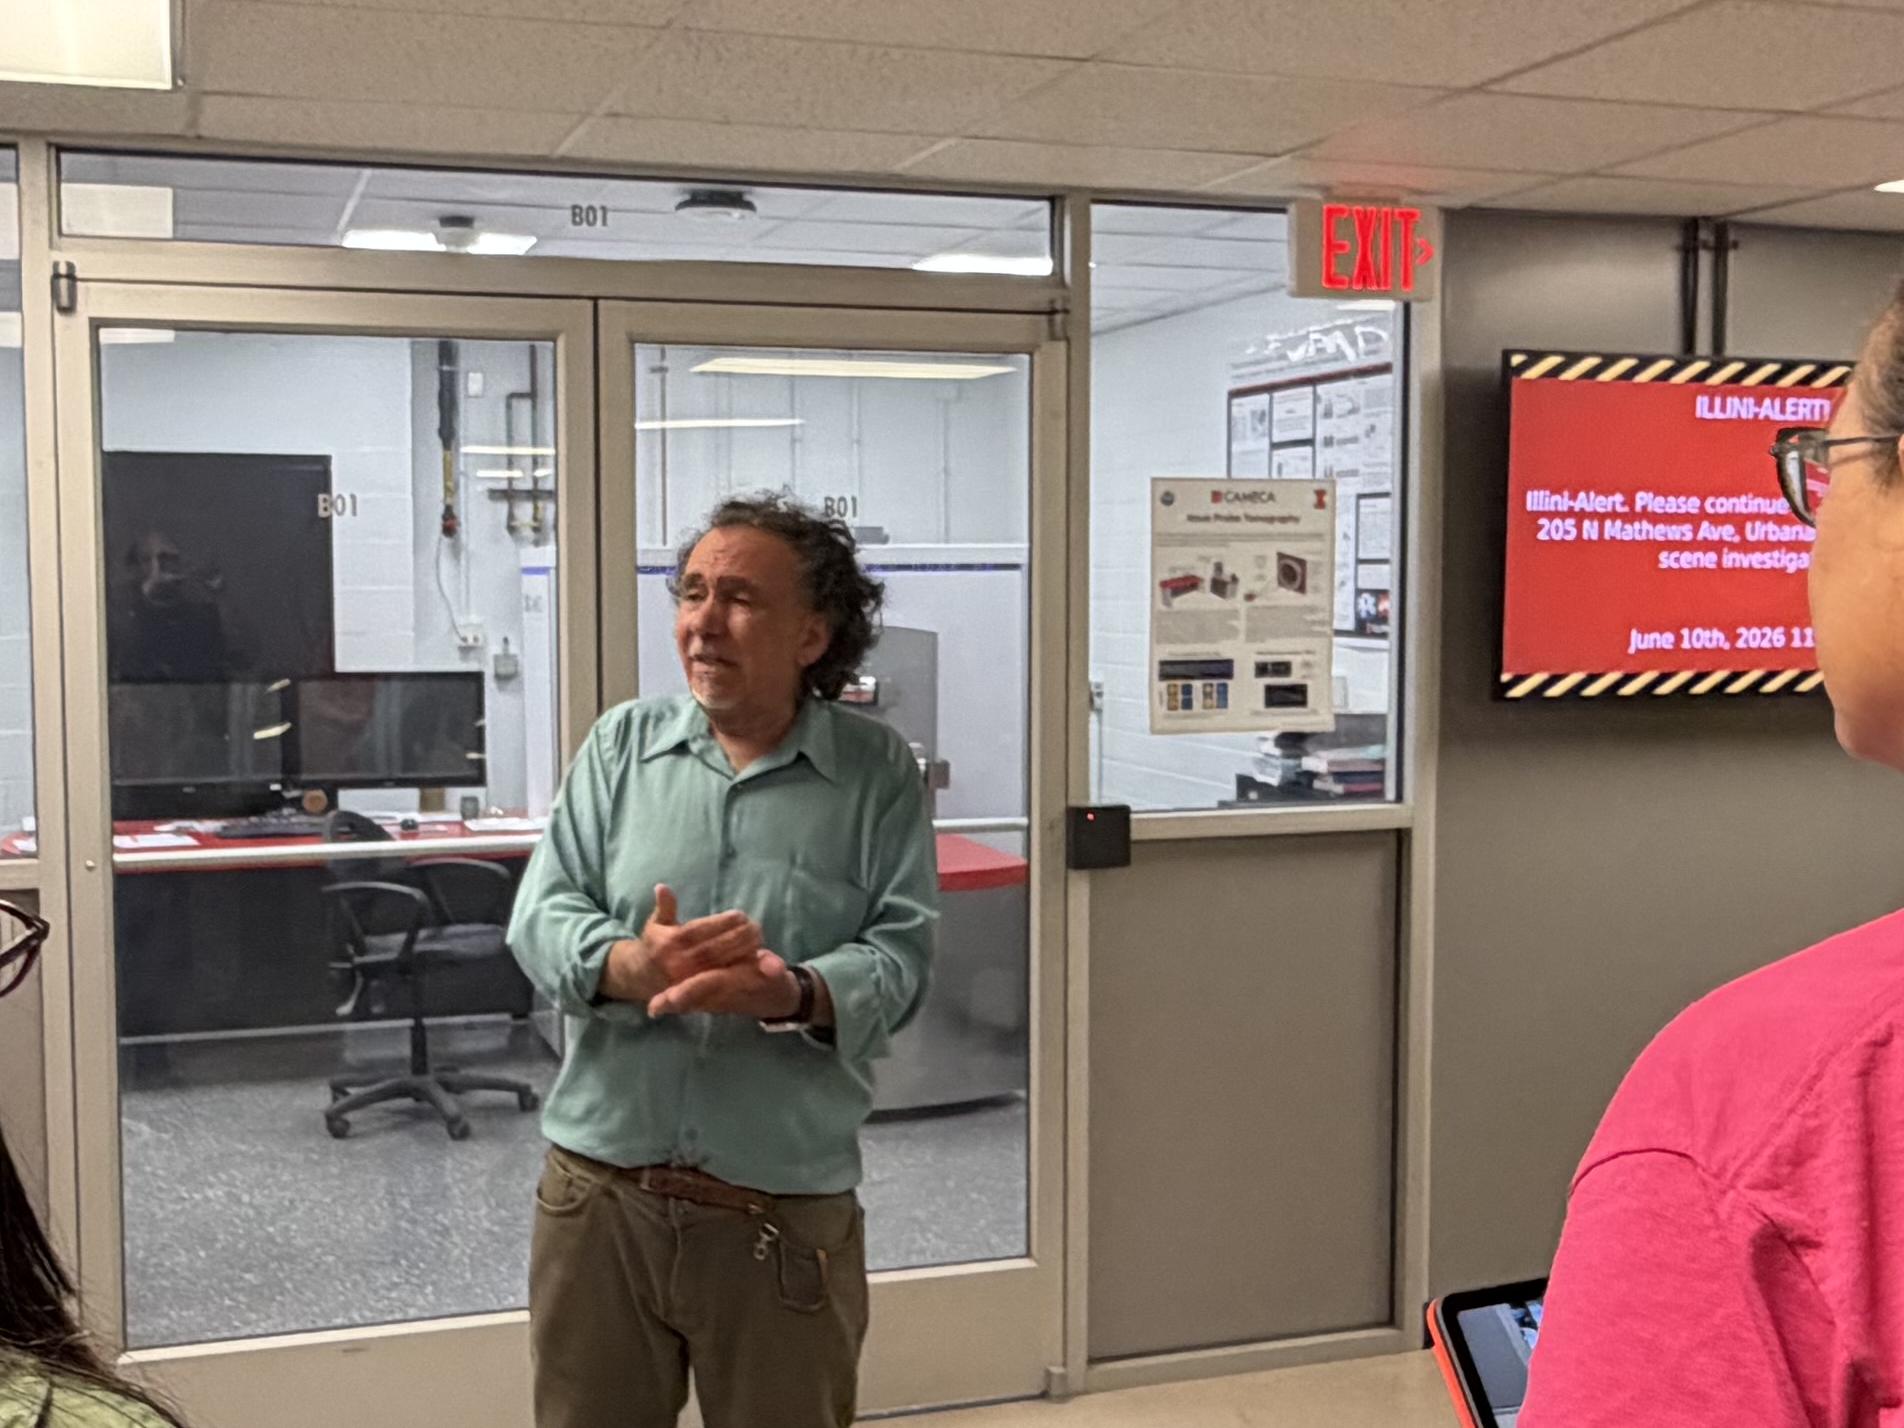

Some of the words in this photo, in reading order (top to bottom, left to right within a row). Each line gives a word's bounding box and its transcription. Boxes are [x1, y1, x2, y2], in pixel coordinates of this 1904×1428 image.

[571, 203, 608, 227] B01
[1323, 205, 1421, 292] EXIT
[317, 493, 358, 518] B01
[823, 495, 858, 519] B01
[1224, 490, 1276, 504] CAMECA
[1635, 491, 1701, 514] Please
[1704, 492, 1792, 514] continue
[1536, 518, 1577, 541] 205
[1582, 519, 1599, 541] N
[1604, 518, 1694, 541] Mathews
[1658, 550, 1718, 569] scene
[1722, 547, 1812, 574] investiga
[1628, 628, 1675, 655] June
[1735, 626, 1786, 649] 2026
